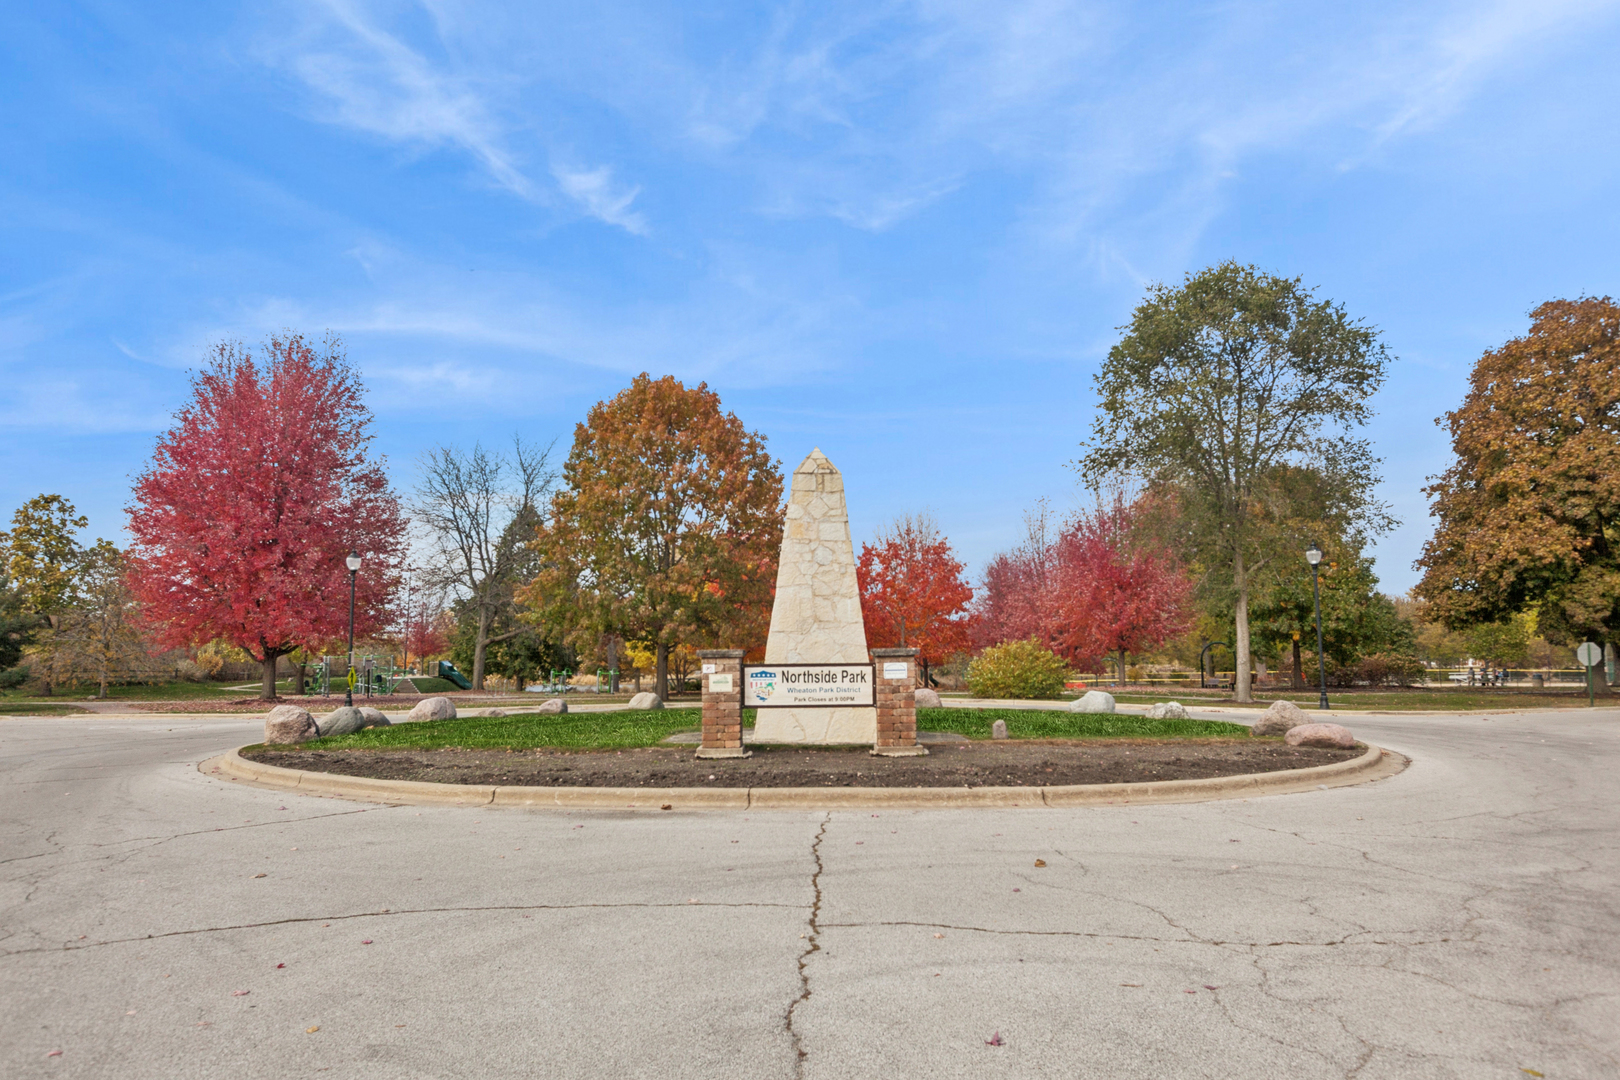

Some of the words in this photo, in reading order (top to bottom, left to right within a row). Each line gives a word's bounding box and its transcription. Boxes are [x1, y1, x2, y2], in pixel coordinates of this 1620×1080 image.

[781, 669, 838, 684] Northside
[841, 669, 867, 684] Park
[818, 686, 835, 694] Park
